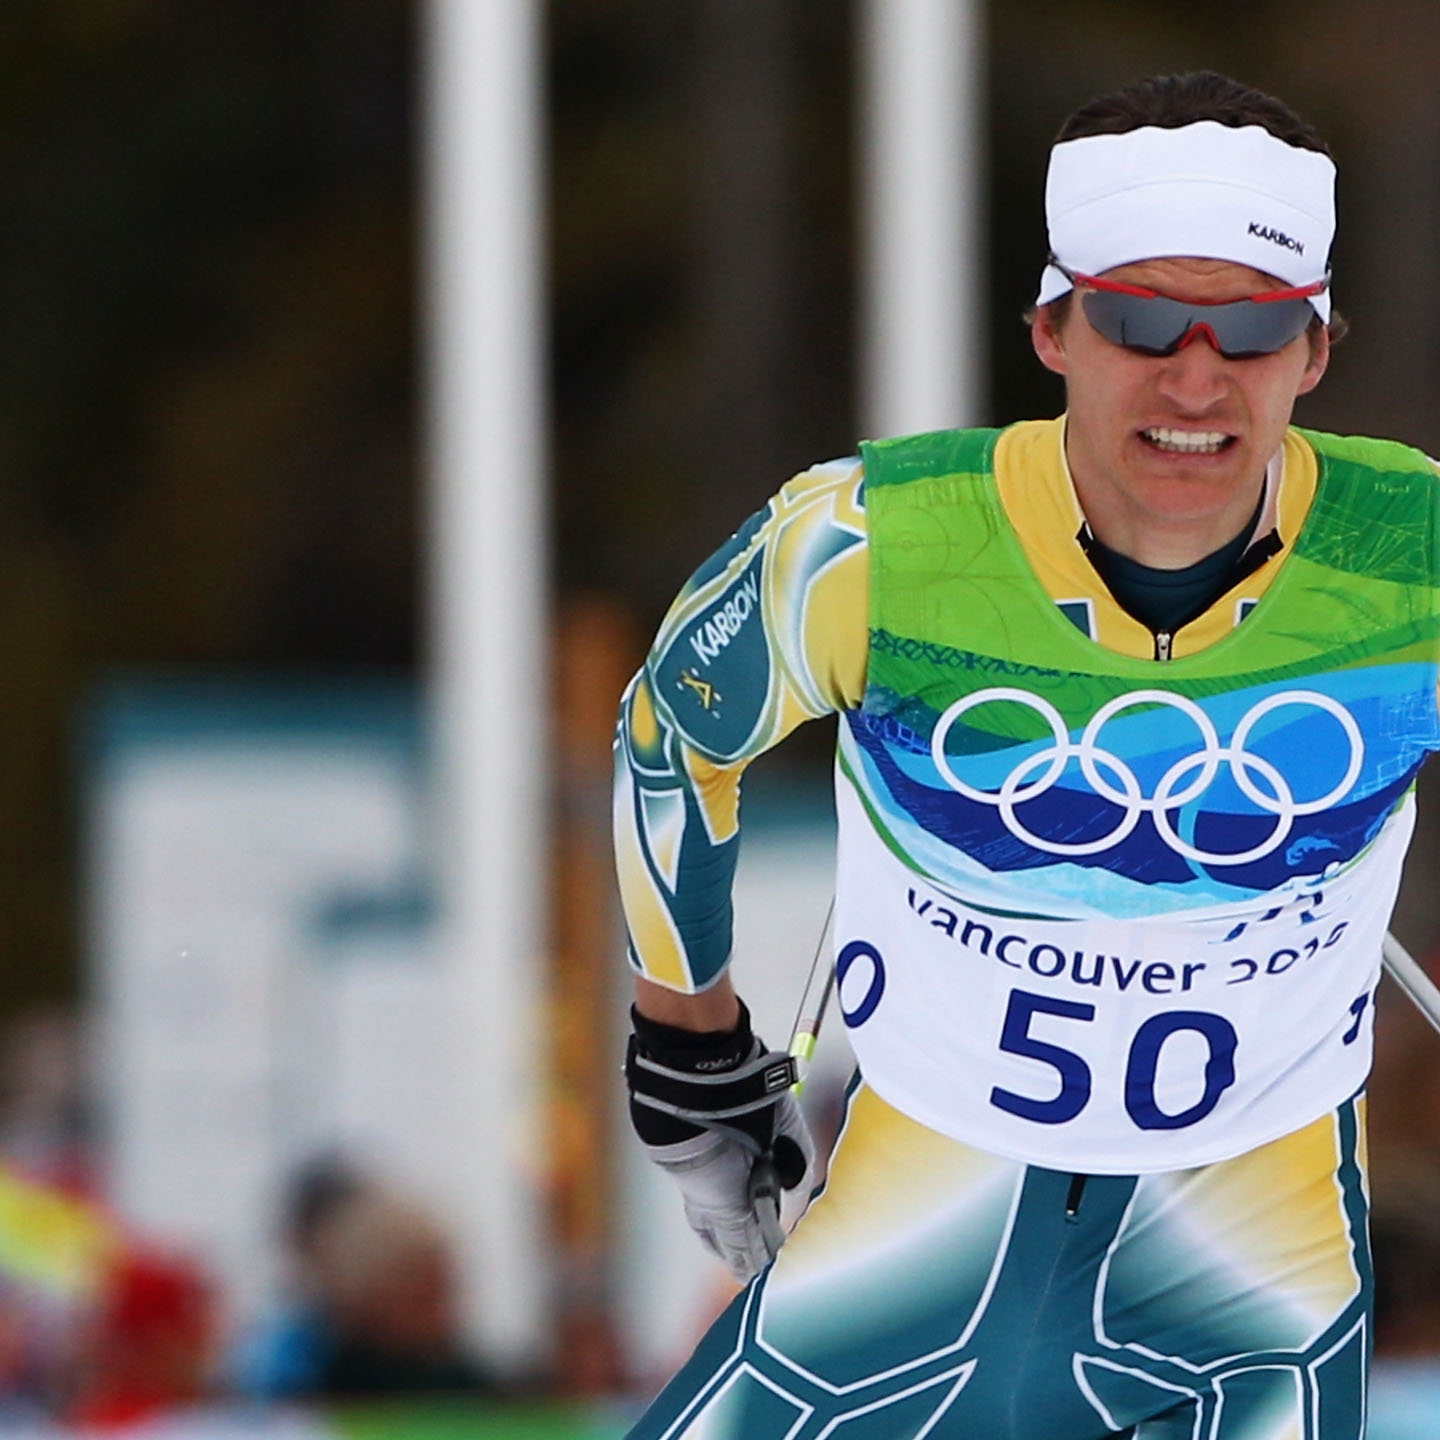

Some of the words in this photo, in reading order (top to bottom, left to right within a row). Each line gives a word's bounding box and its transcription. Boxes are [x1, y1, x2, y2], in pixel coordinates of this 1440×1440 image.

[1247, 221, 1305, 257] KARBON
[689, 570, 760, 667] KARBON
[906, 886, 1207, 995] vancouver
[989, 987, 1239, 1131] 50
